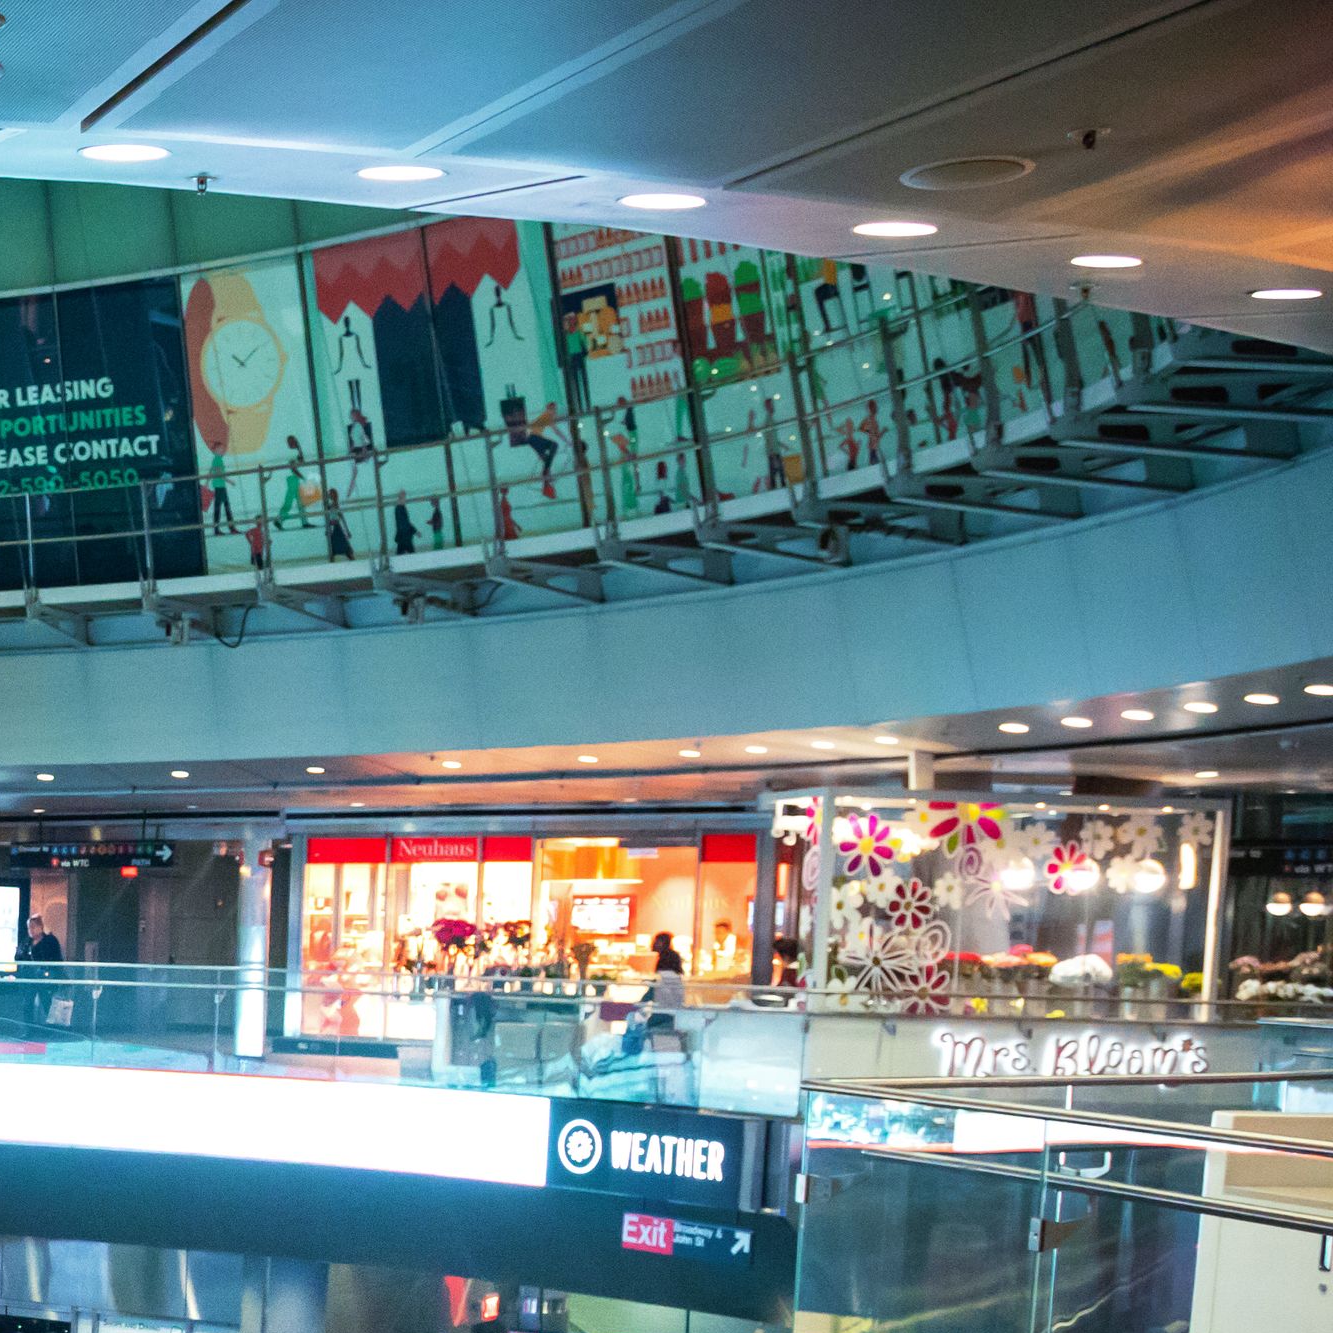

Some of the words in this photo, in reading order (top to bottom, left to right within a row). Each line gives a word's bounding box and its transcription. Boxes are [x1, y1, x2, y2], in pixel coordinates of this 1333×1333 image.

[15, 376, 114, 406] LEASING
[53, 434, 160, 464] CONTACT
[398, 839, 475, 859] Neuhaus
[610, 1129, 725, 1182] WEATHER
[621, 1213, 667, 1248] Exit
